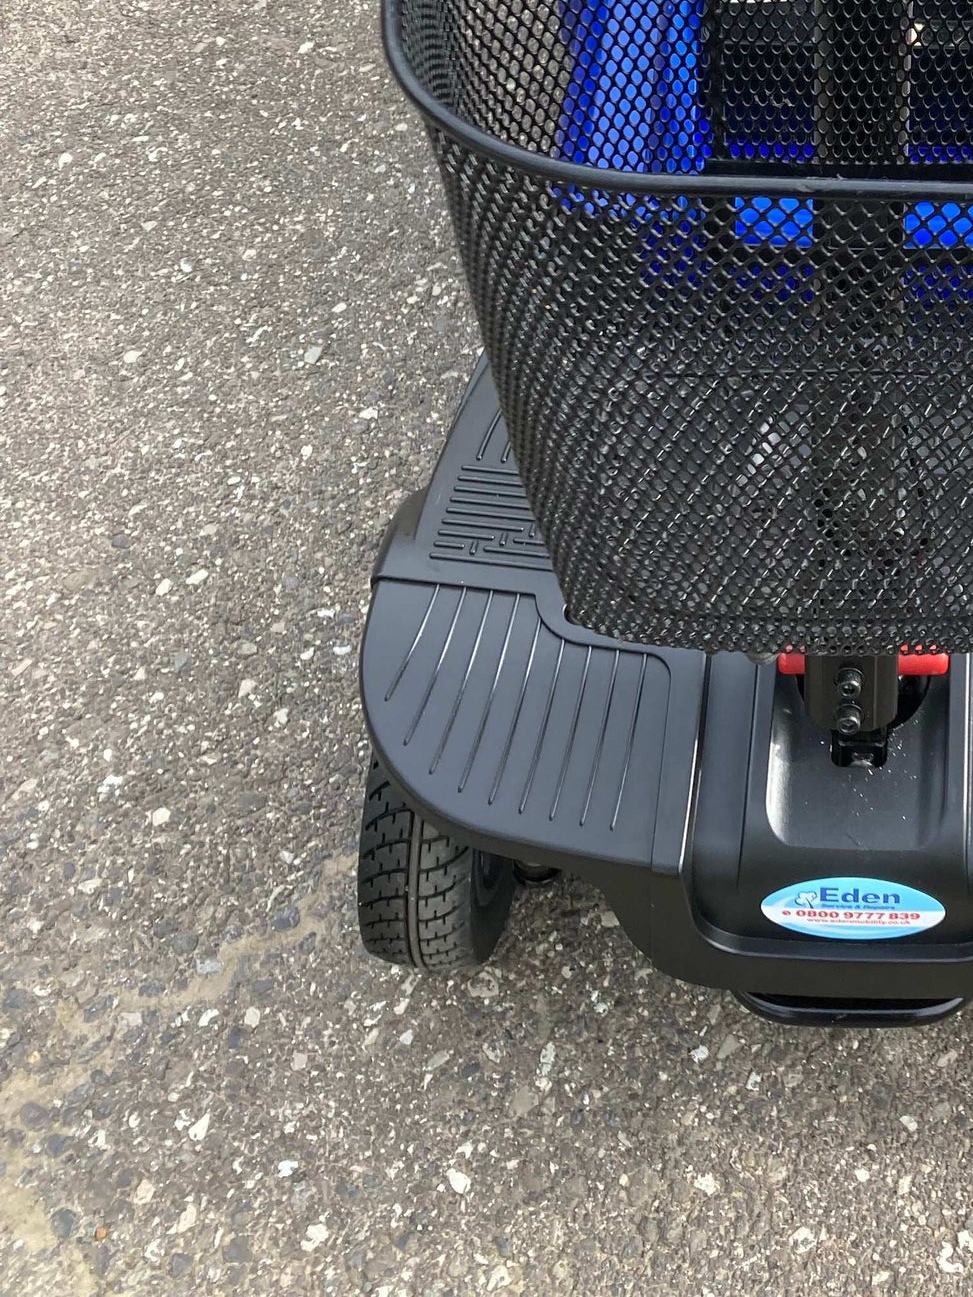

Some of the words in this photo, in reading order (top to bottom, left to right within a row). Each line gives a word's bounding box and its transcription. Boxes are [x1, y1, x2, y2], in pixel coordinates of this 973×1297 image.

[819, 886, 901, 904] Eden
[796, 909, 839, 919] 0800
[843, 911, 885, 920] 9777
[888, 912, 921, 920] 839
